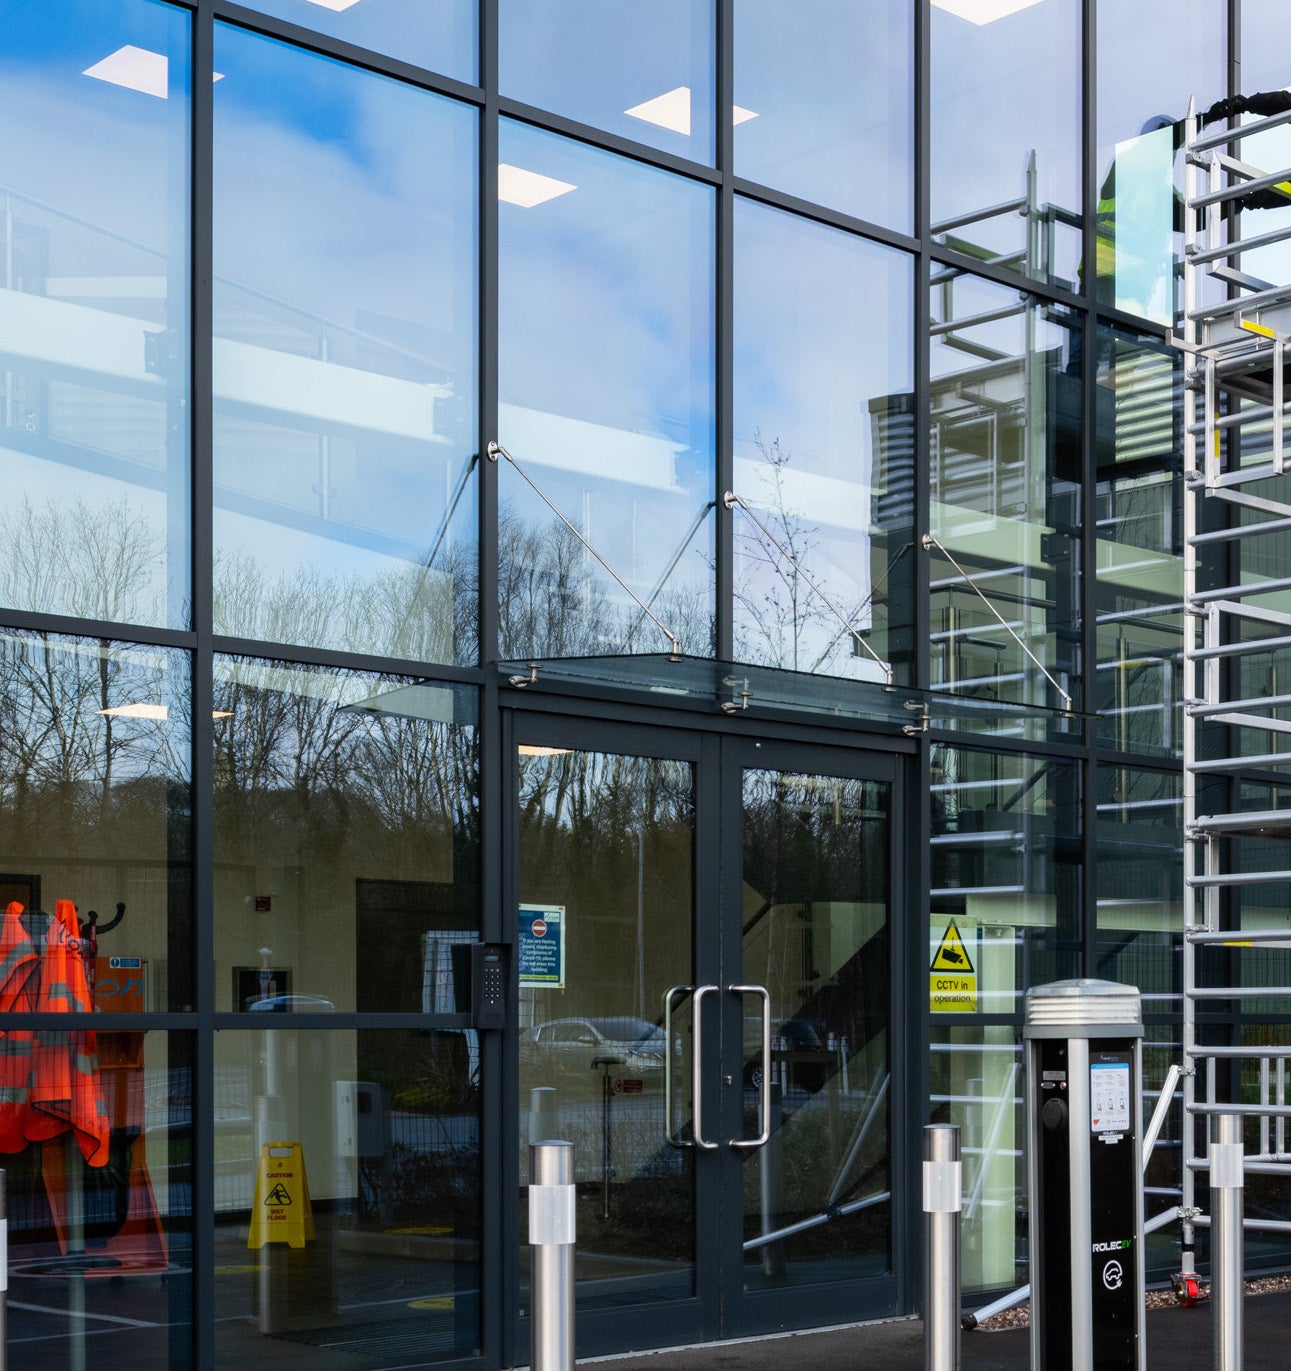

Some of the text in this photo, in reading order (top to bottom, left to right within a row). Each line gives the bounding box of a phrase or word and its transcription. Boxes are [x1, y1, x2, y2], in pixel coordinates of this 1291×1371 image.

[937, 981, 968, 990] CCTV in
[934, 995, 971, 1004] operation
